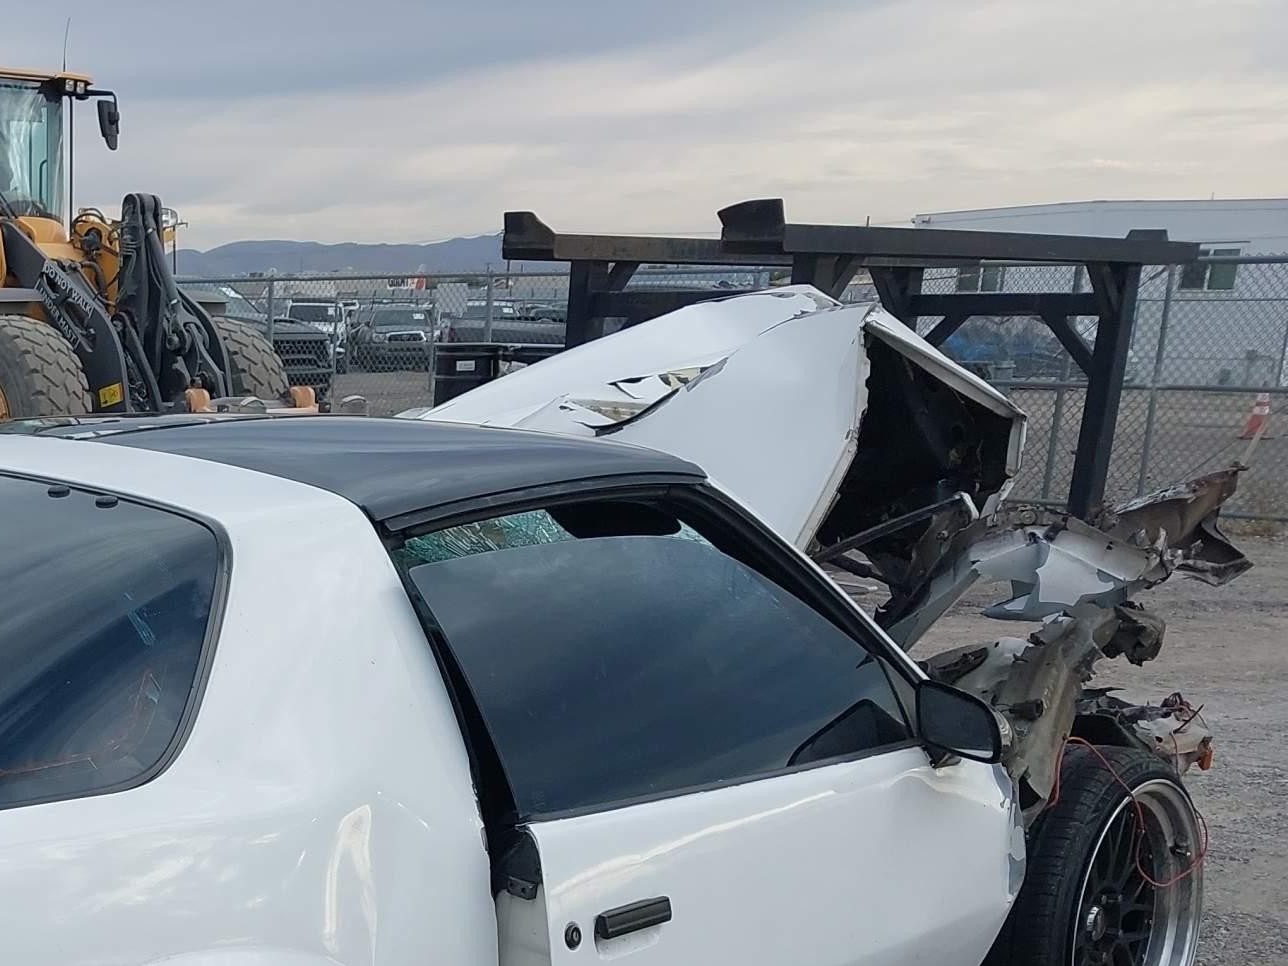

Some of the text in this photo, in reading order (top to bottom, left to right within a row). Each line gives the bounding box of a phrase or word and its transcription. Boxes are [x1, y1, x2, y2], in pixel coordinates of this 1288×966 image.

[39, 287, 77, 343] UNDER MAST
[43, 263, 93, 315] DO NOT WALK
